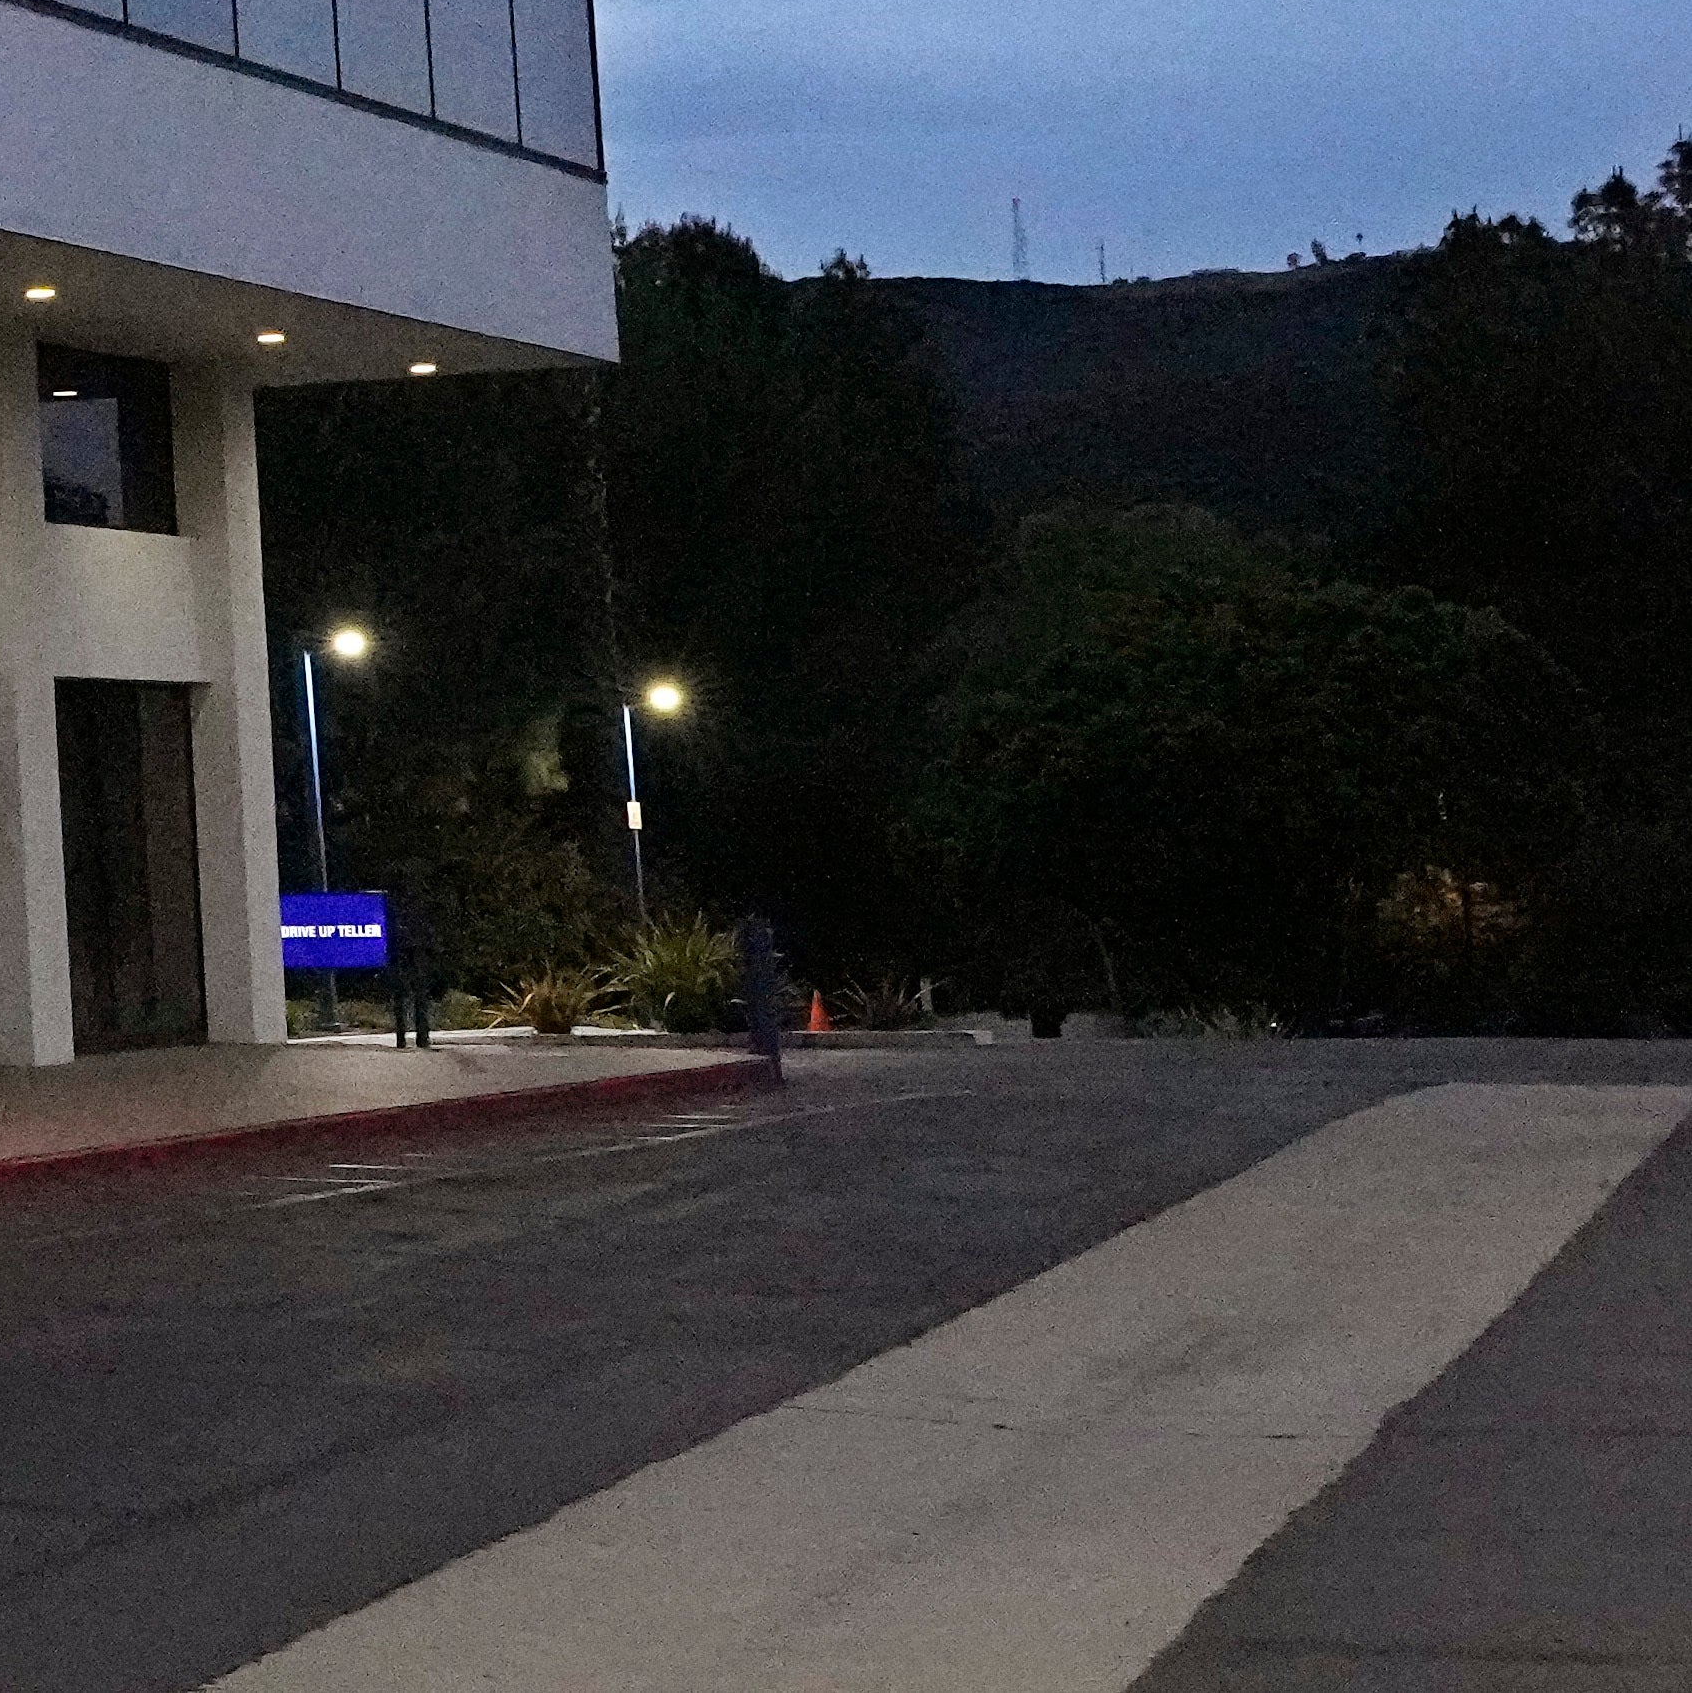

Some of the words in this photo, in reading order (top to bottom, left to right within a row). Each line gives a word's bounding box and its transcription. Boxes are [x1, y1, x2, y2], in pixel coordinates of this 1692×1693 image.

[280, 925, 316, 938] DRIVE
[318, 925, 336, 938] UP
[337, 924, 382, 938] TELLER
